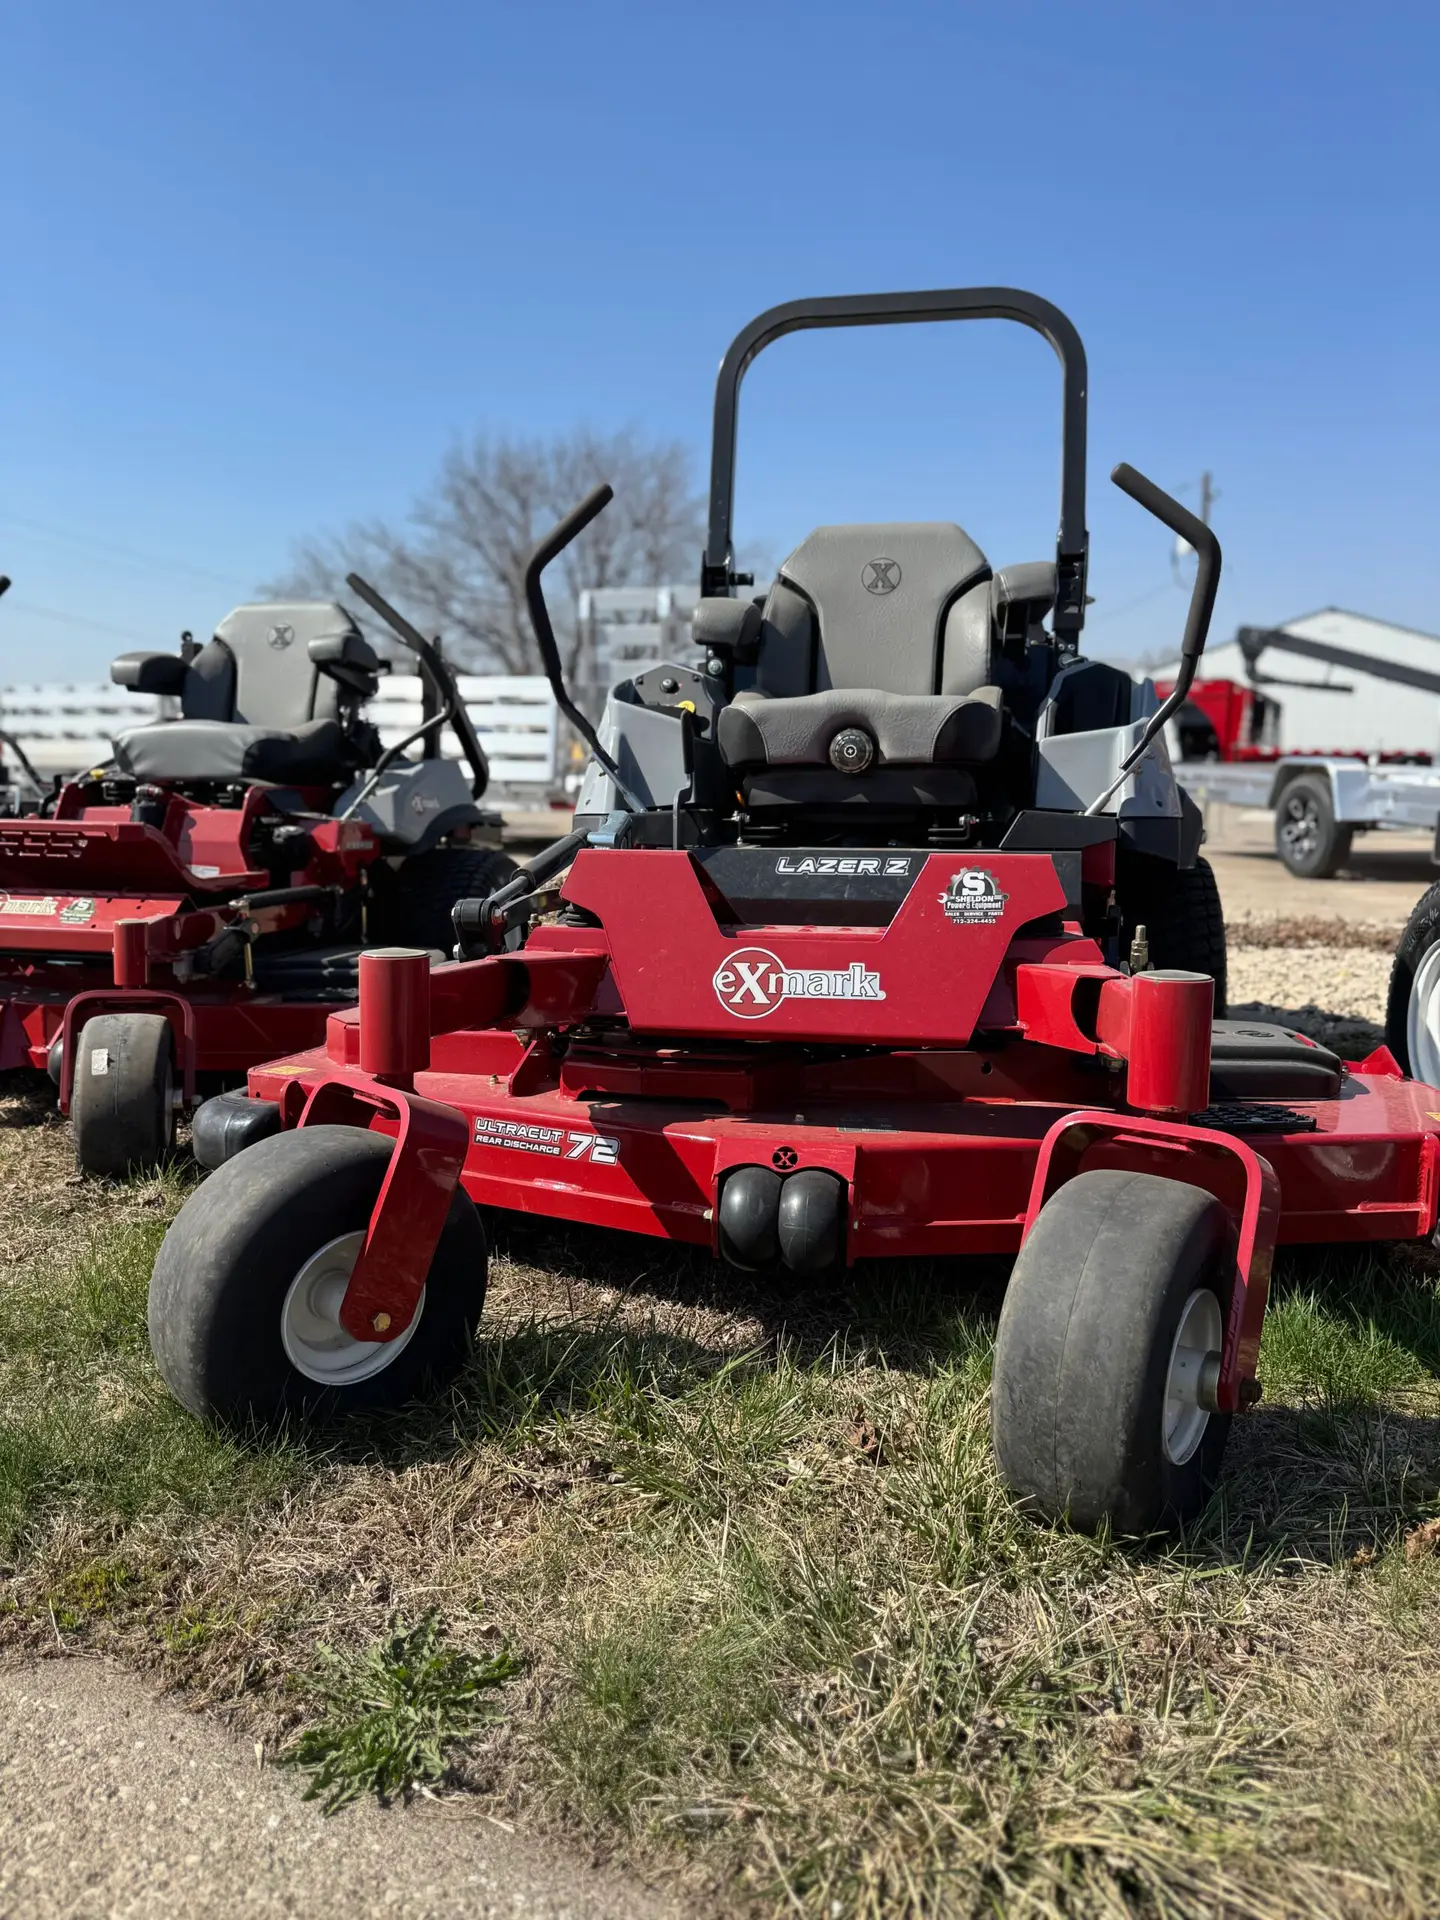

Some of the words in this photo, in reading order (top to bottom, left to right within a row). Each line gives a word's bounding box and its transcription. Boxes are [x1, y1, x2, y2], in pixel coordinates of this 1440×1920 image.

[867, 562, 897, 589] X
[776, 857, 880, 875] LAZER
[882, 857, 911, 876] Z
[962, 872, 985, 896] S
[971, 902, 1002, 910] Equipment
[475, 1117, 565, 1143] ULTRACUT
[475, 1134, 504, 1146] REAR
[503, 1139, 562, 1156] DISCHARGE
[564, 1131, 621, 1166] 72
